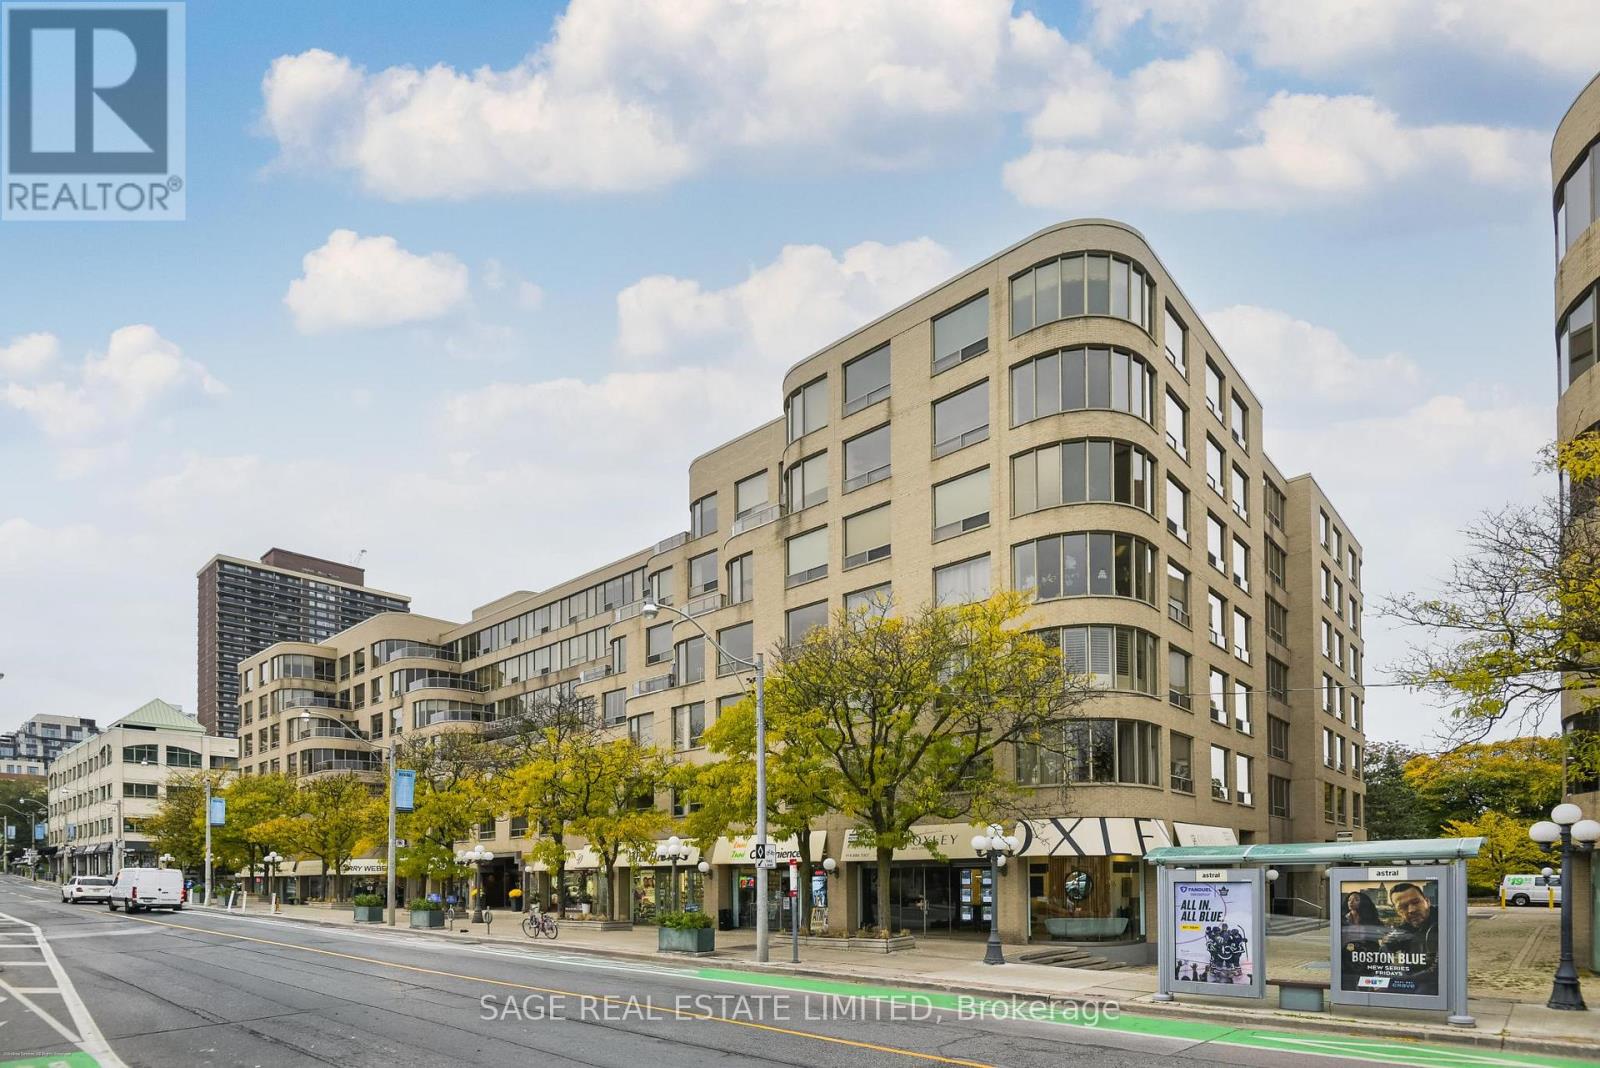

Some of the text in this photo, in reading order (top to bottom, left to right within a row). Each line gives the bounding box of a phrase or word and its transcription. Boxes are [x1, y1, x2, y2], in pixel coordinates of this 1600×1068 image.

[749, 847, 802, 860] Cnience
[1181, 900, 1211, 910] ALL IN.
[1181, 911, 1224, 922] ALL BLUE.
[1352, 952, 1426, 964] BOSTON BLUE
